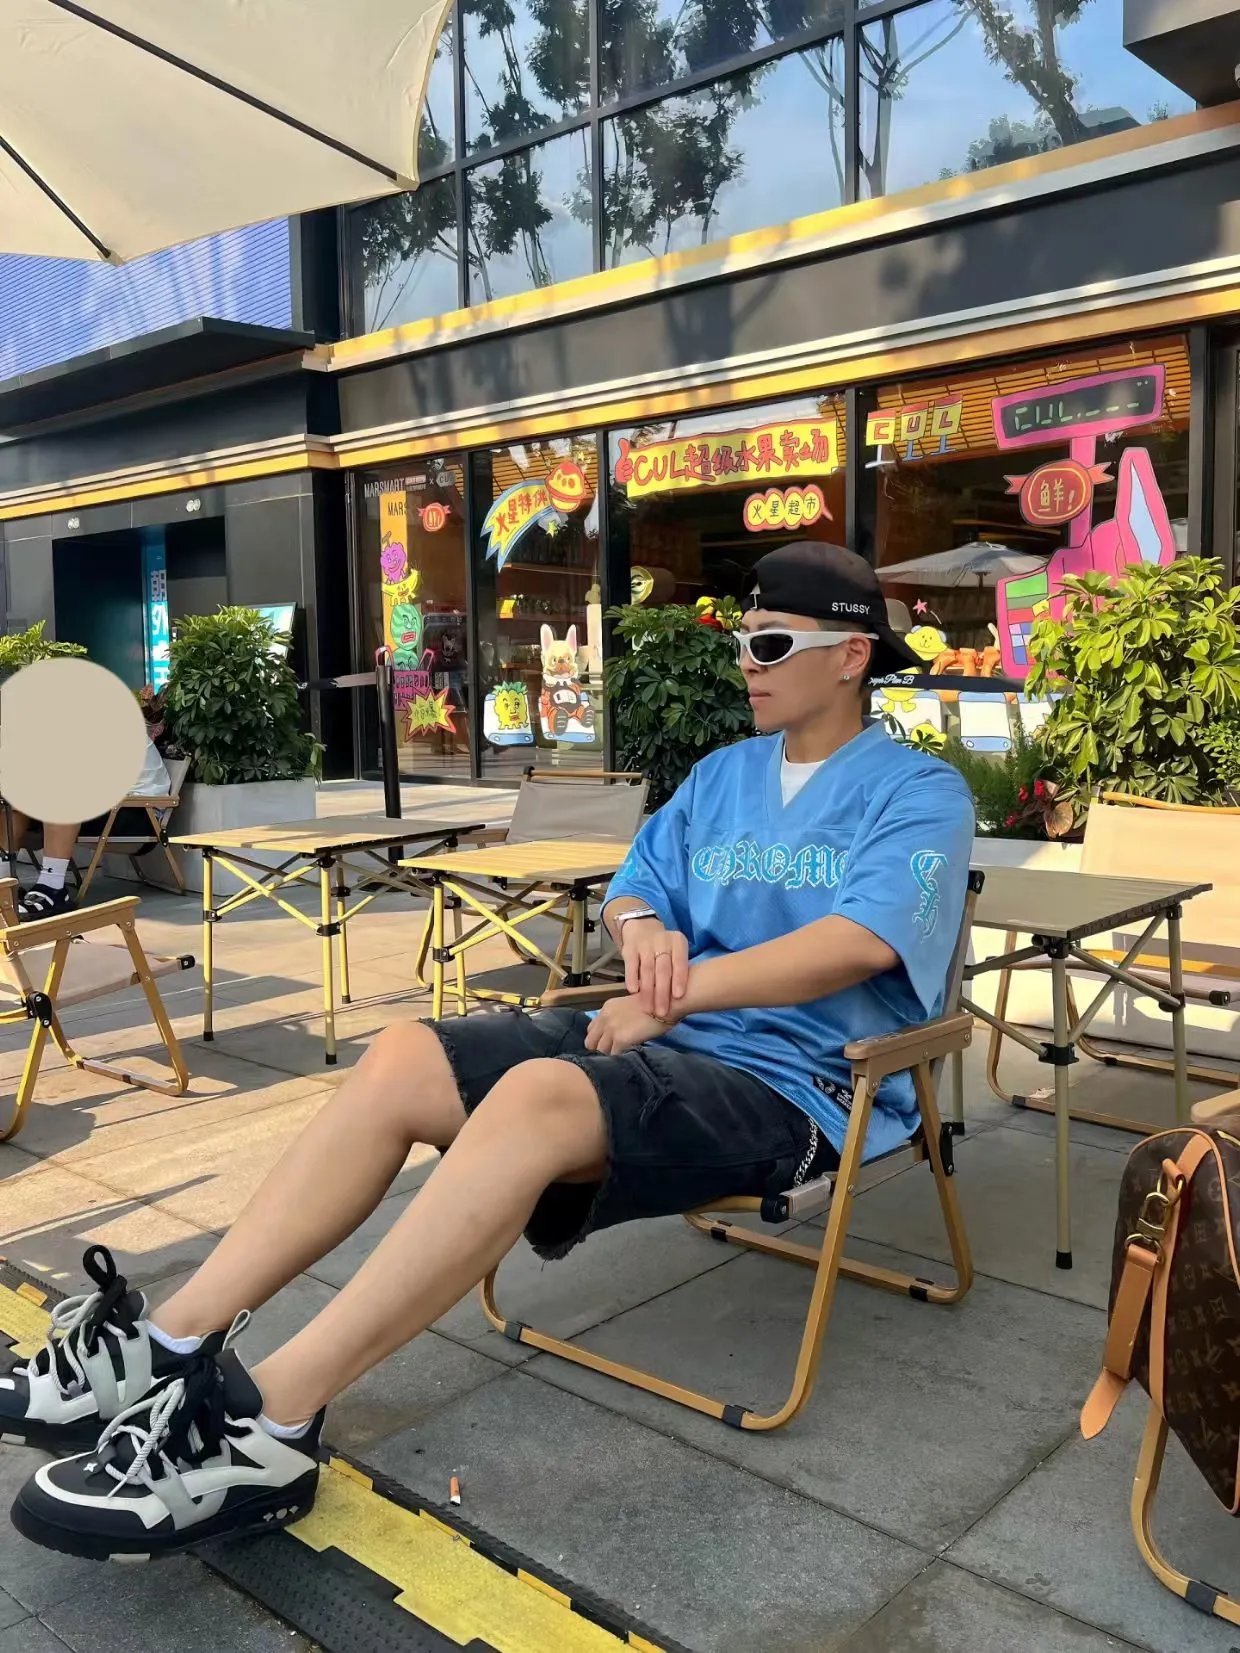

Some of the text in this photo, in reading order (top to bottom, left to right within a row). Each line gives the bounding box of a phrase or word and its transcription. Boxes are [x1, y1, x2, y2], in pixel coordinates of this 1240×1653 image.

[751, 495, 821, 520] 火星超市
[831, 602, 871, 615] STUSSY
